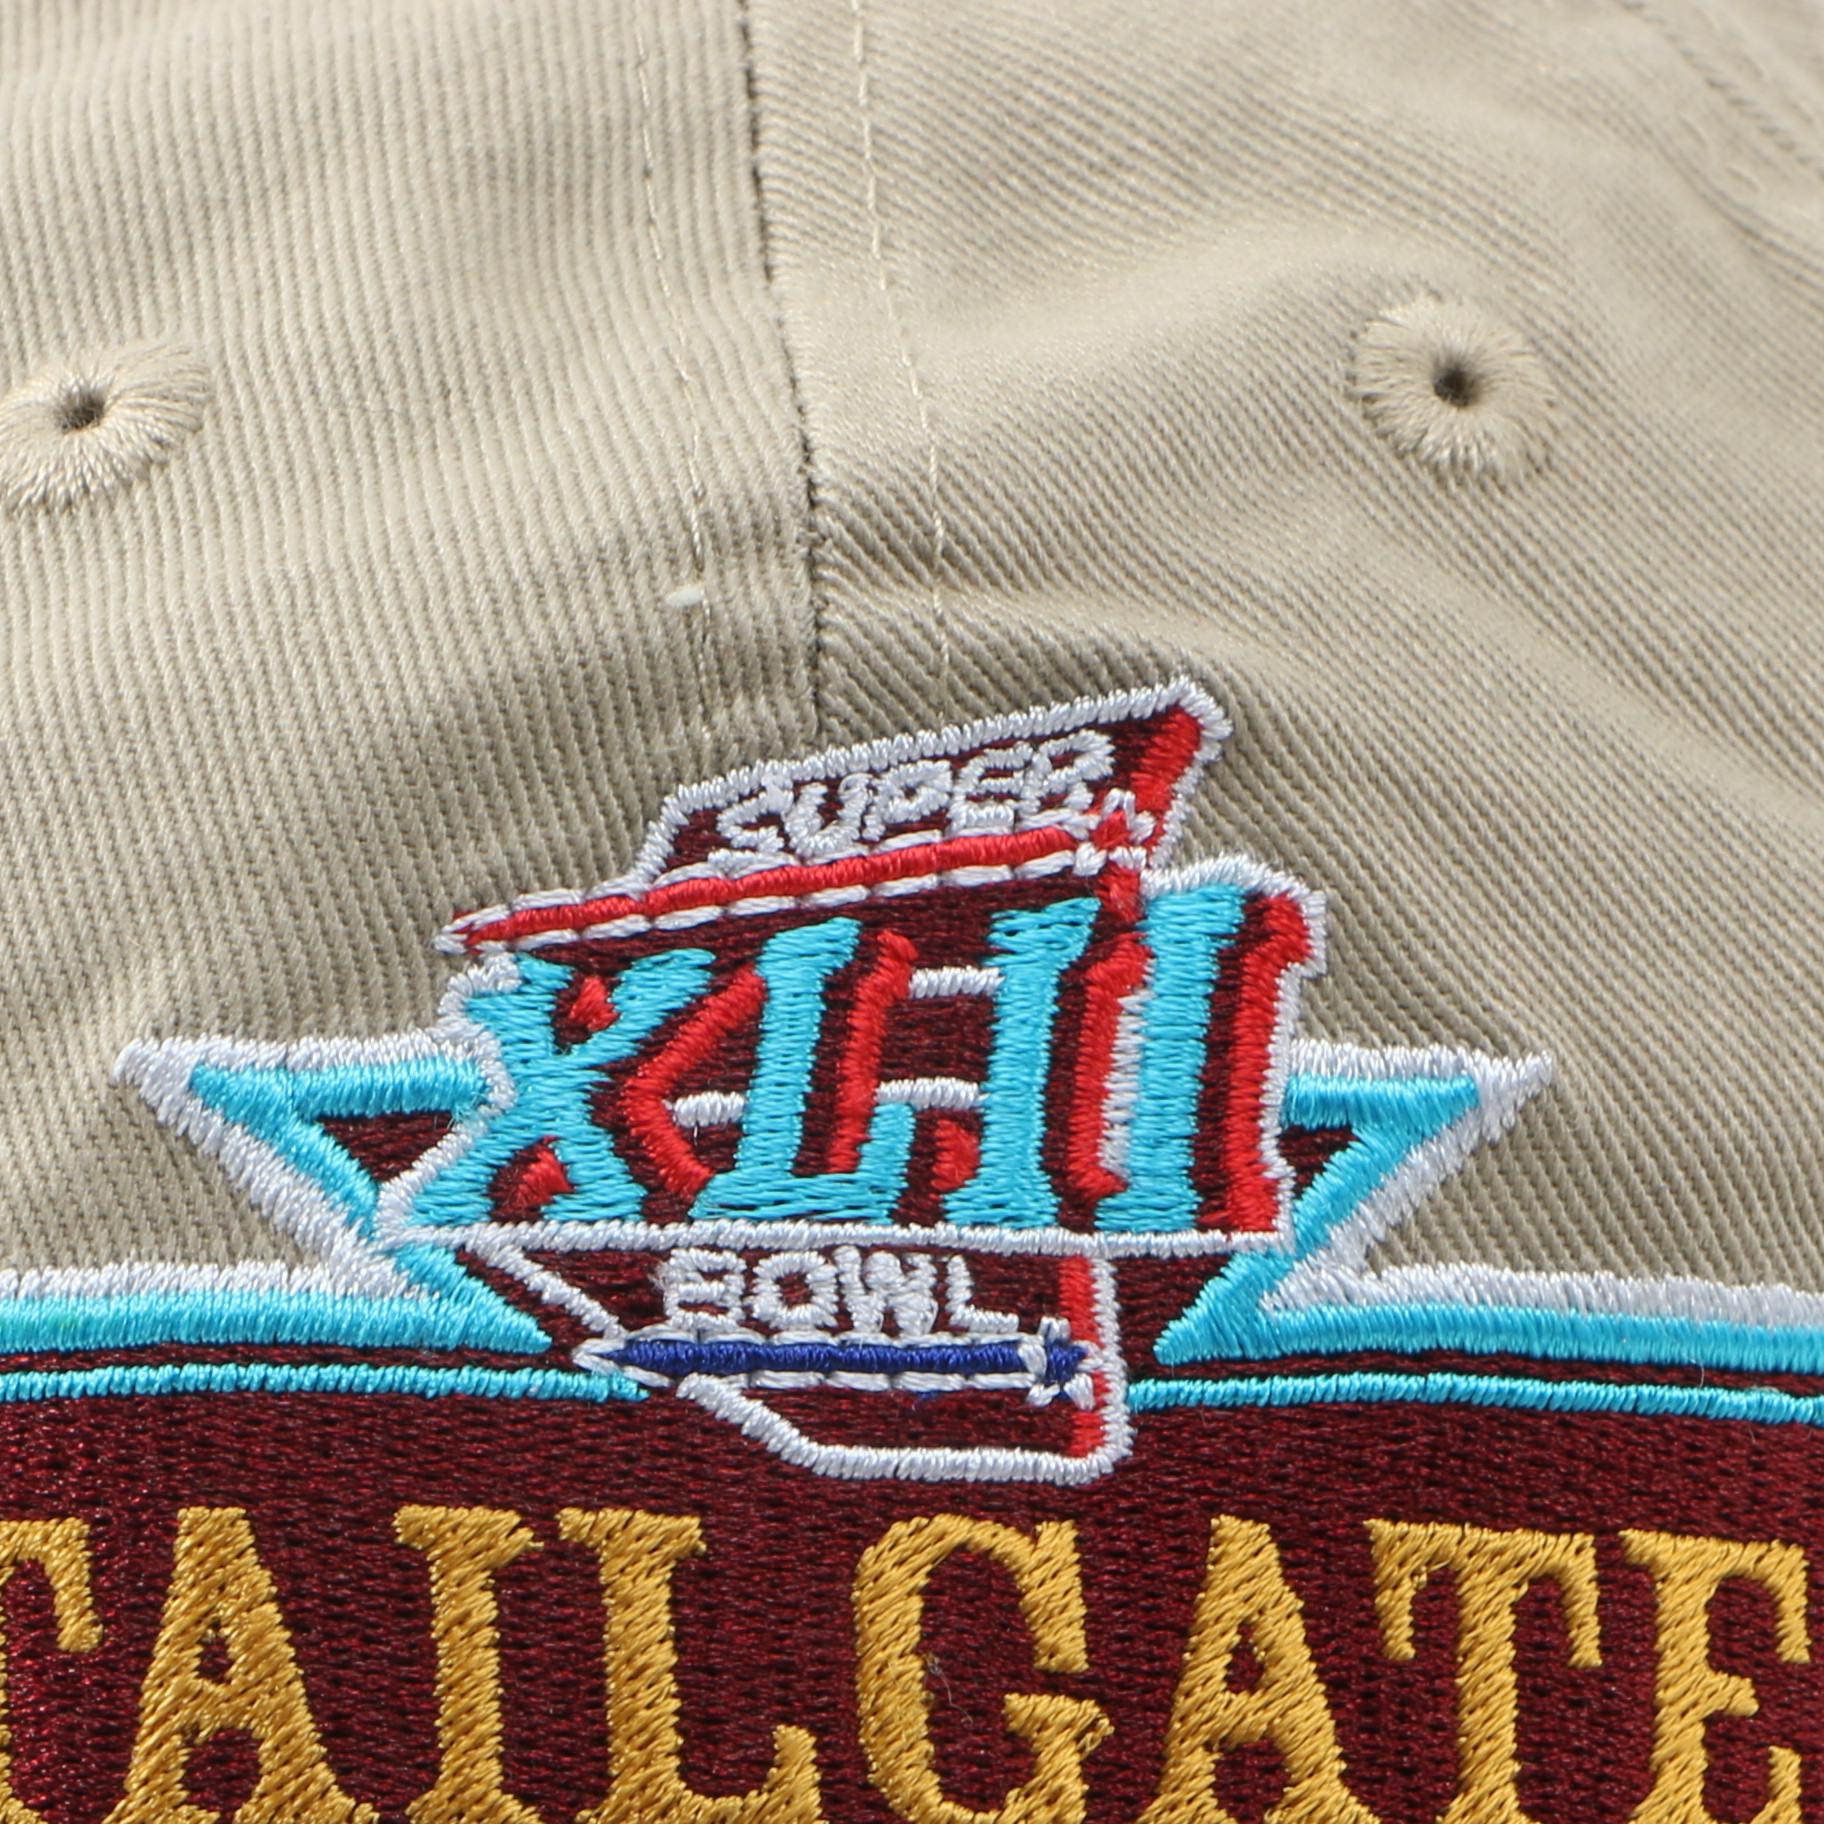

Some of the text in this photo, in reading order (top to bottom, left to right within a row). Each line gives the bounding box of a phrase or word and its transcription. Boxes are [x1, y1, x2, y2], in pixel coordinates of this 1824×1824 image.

[717, 728, 1114, 855] SUPER
[400, 885, 1276, 1232] XLII
[656, 1245, 1018, 1333] BOWL
